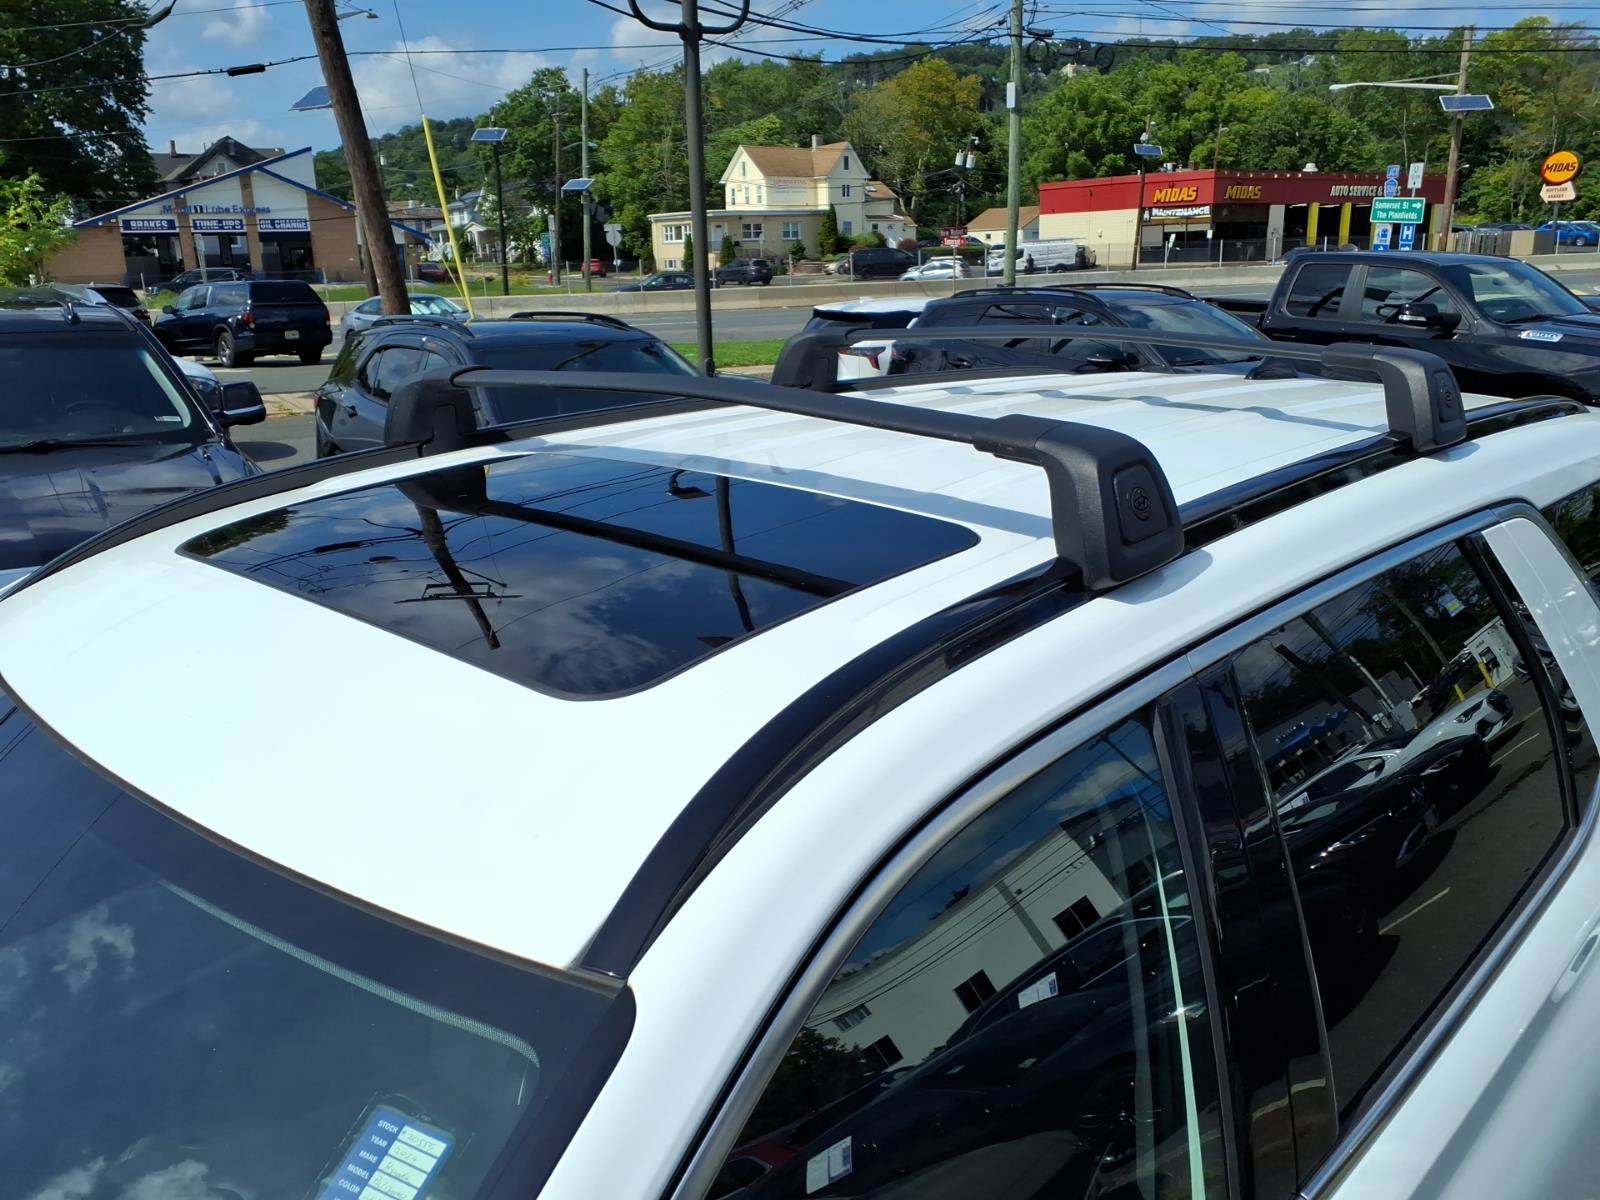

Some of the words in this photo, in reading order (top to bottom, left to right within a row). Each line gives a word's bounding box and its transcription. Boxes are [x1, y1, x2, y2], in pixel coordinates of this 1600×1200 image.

[1544, 162, 1577, 174] MIDAS
[1153, 186, 1199, 204] MIDAS
[1223, 185, 1262, 200] MIDAS
[1330, 185, 1348, 196] AUTO
[1349, 185, 1377, 196] SERVICE
[205, 204, 231, 214] Lube
[232, 204, 271, 216] Express
[1152, 205, 1211, 217] MAINTENANCE
[1375, 201, 1401, 209] Somerset
[1402, 201, 1409, 209] St
[1376, 211, 1387, 219] The
[1388, 211, 1418, 219] Plainfields
[130, 220, 168, 230] BRAKES
[195, 220, 241, 230] TUNE-UPS
[260, 220, 274, 229] OIL
[275, 219, 308, 229] CHANGE
[1402, 225, 1413, 240] H
[377, 1119, 399, 1134] STOCK
[370, 1135, 388, 1148] YEAR
[359, 1150, 378, 1163] MAKE
[347, 1163, 370, 1180] MODEL
[338, 1179, 360, 1194] COLOR
